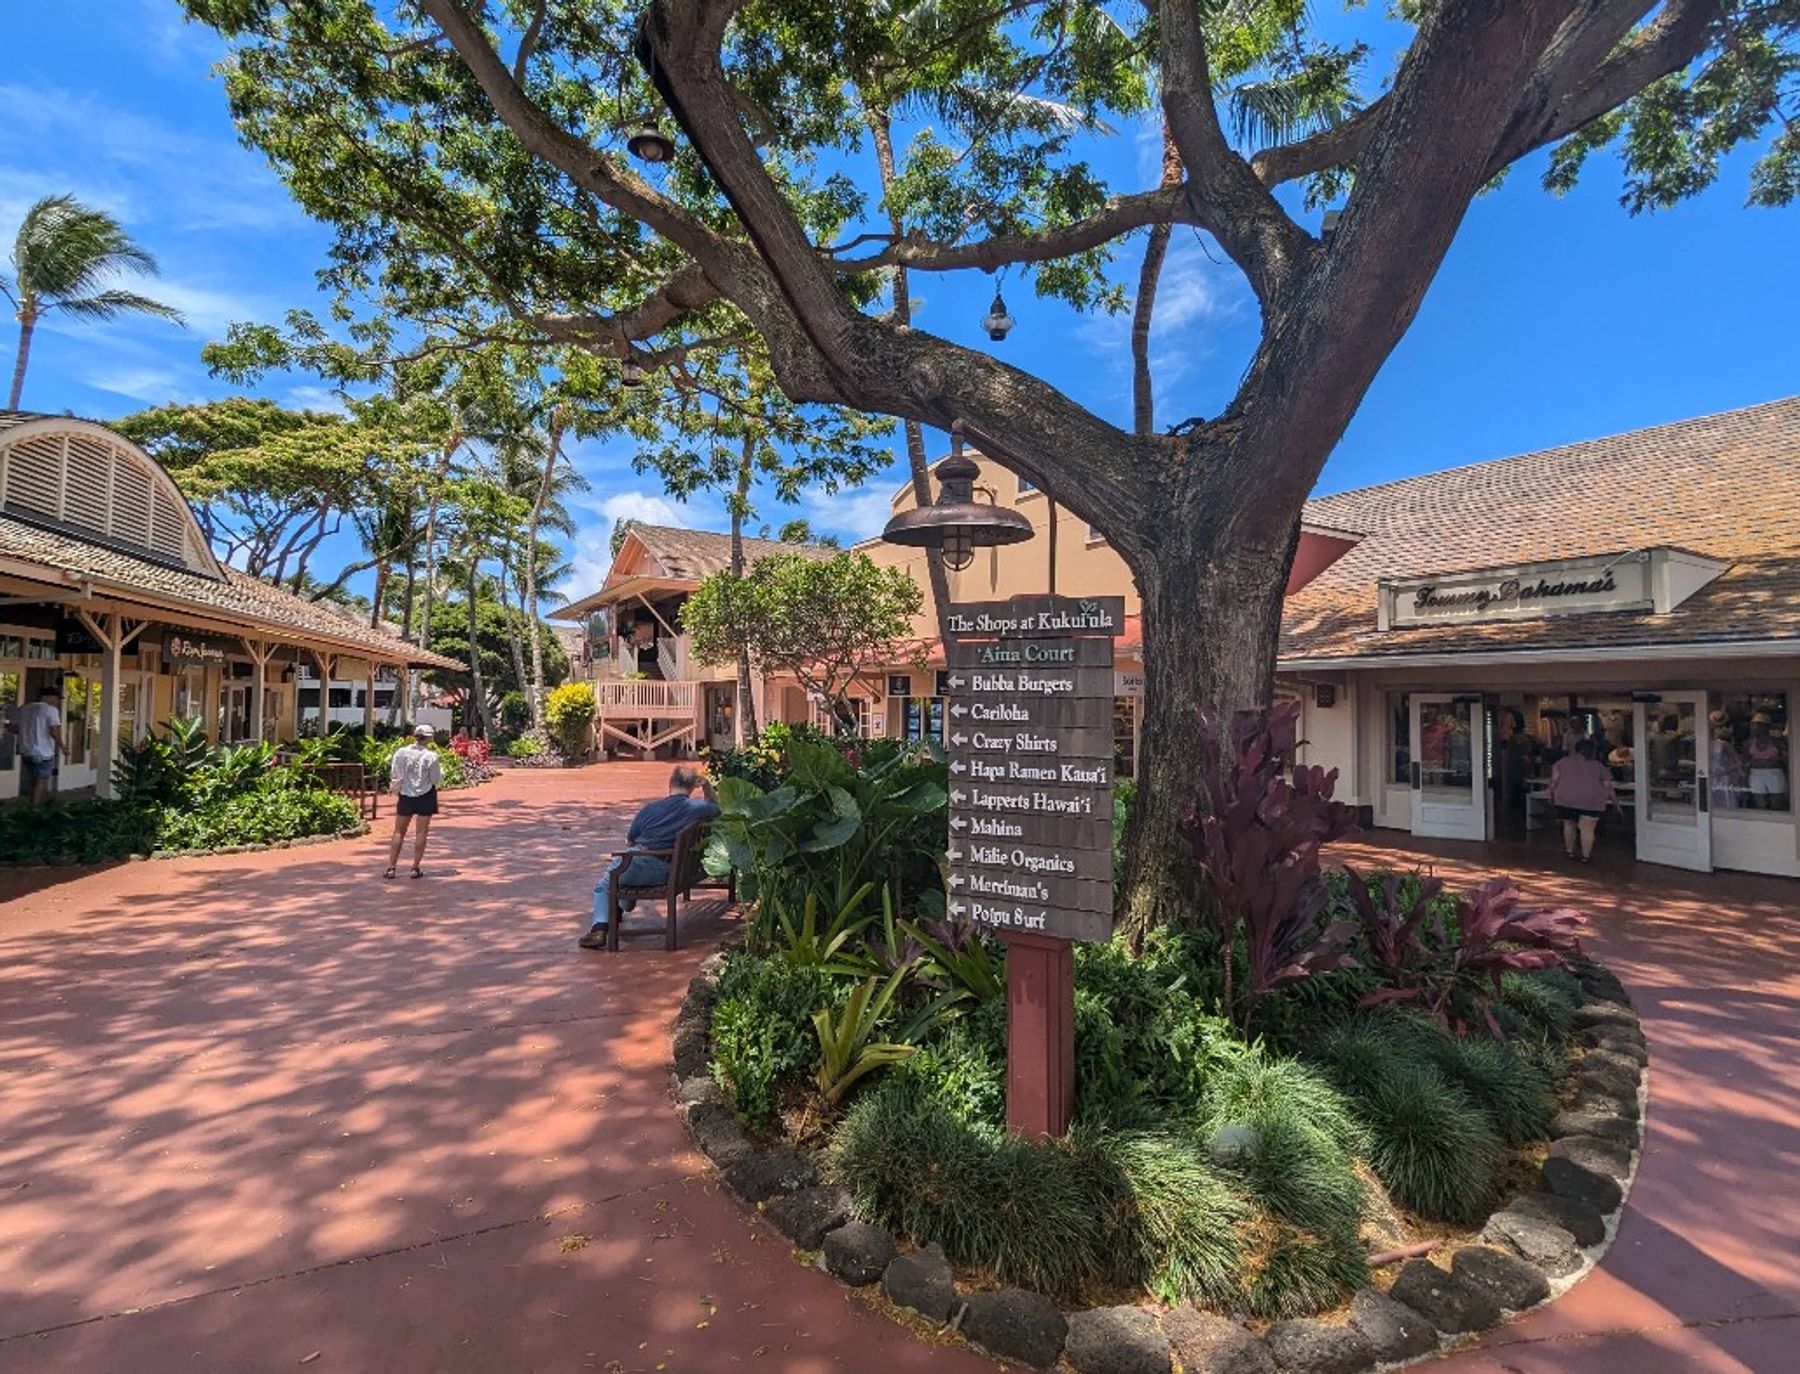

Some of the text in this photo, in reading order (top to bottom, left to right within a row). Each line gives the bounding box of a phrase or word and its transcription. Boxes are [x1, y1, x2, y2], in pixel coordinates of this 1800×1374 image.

[1413, 586, 1492, 610] Tommy
[948, 615, 974, 632] The
[976, 613, 1018, 635] Shops
[1020, 617, 1035, 630] at
[1024, 645, 1074, 662] Court
[972, 675, 1073, 694] Bubba Burgers
[971, 704, 1030, 721] Cariloha
[972, 732, 1058, 752] Crazy Shirts
[970, 760, 1005, 781] Hapa
[1009, 761, 1057, 780] Ramen
[972, 789, 1030, 811] Lapperts
[970, 817, 1023, 836] Mahina
[1011, 850, 1075, 873] Organics
[969, 874, 1049, 900] Merriman's
[972, 903, 1046, 930] Poipu Surf
